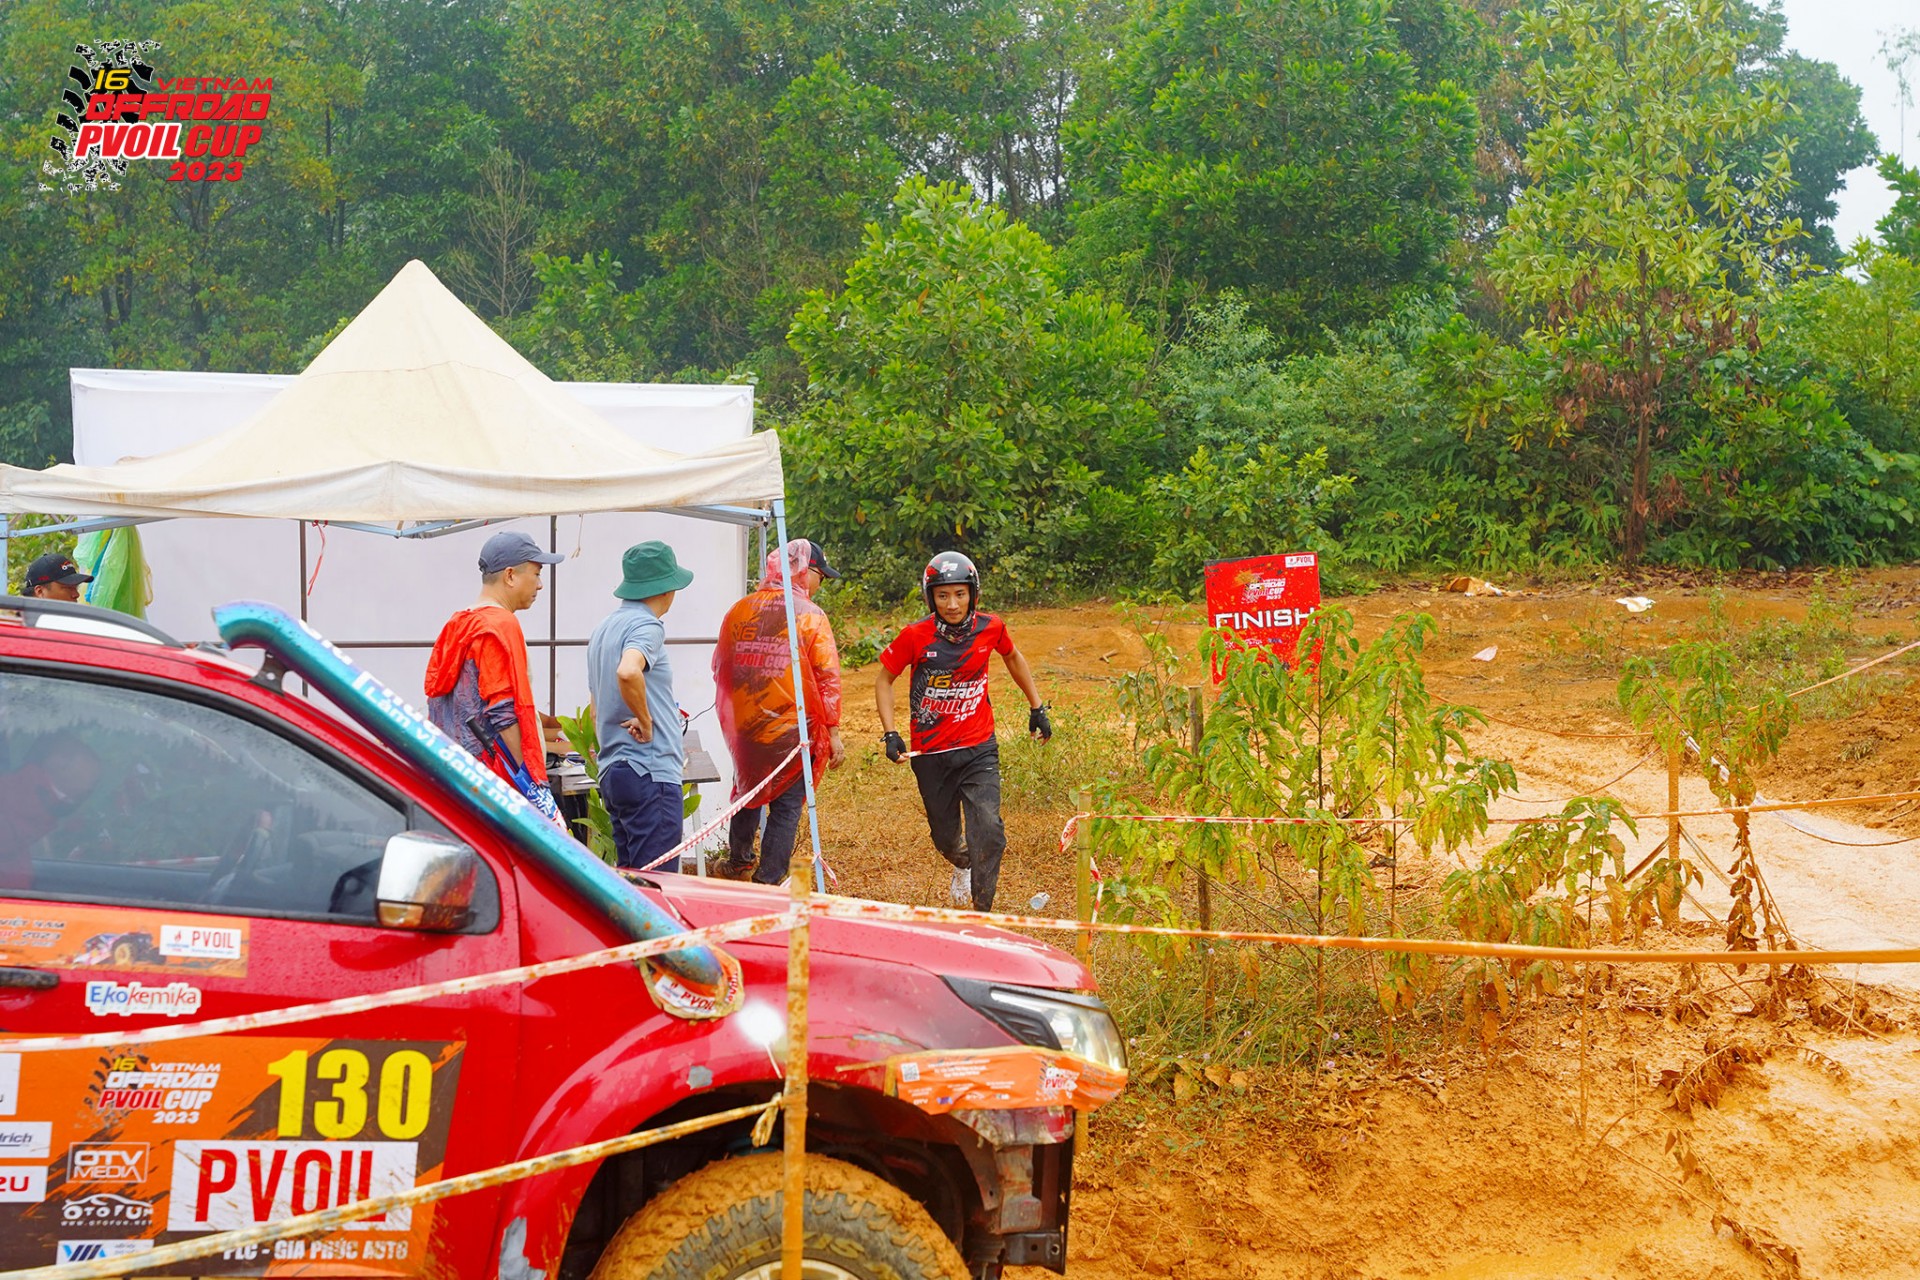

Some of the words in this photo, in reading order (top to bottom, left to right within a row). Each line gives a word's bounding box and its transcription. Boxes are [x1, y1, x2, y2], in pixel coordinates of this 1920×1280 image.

[1215, 607, 1316, 630] FINISH
[927, 674, 953, 689] 16
[921, 696, 962, 715] PVOIL
[191, 930, 235, 949] PVOIL
[90, 985, 197, 1006] Ekokemika
[113, 1057, 137, 1071] 16
[150, 1062, 221, 1072] VIETNAM
[105, 1071, 219, 1089] OFFROAD
[98, 1090, 163, 1110] PVOIL
[164, 1090, 213, 1110] CUP
[267, 1048, 433, 1140] 130
[152, 1111, 199, 1124] 2023
[74, 1150, 144, 1166] OTV
[74, 1166, 143, 1182] MEDIA
[195, 1149, 387, 1223] PVOIL
[274, 1240, 306, 1260] GIA
